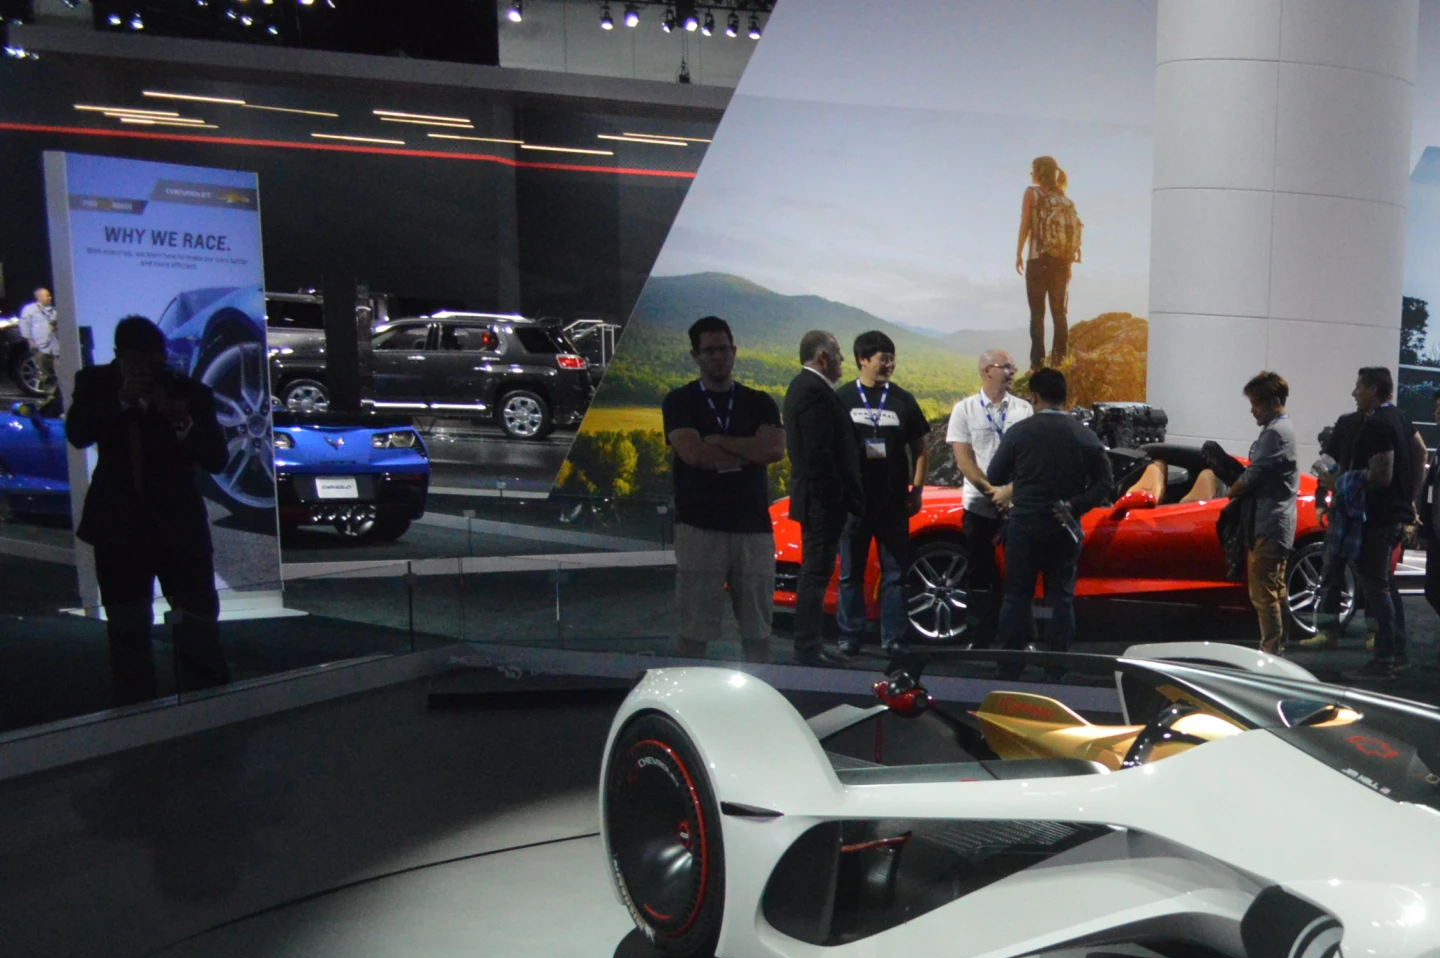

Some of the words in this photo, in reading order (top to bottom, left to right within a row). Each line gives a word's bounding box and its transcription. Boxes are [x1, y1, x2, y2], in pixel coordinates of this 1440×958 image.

[104, 226, 147, 244] WHY
[152, 229, 178, 247] WE
[182, 232, 231, 251] RACE.
[853, 411, 896, 419] CHAARAL
